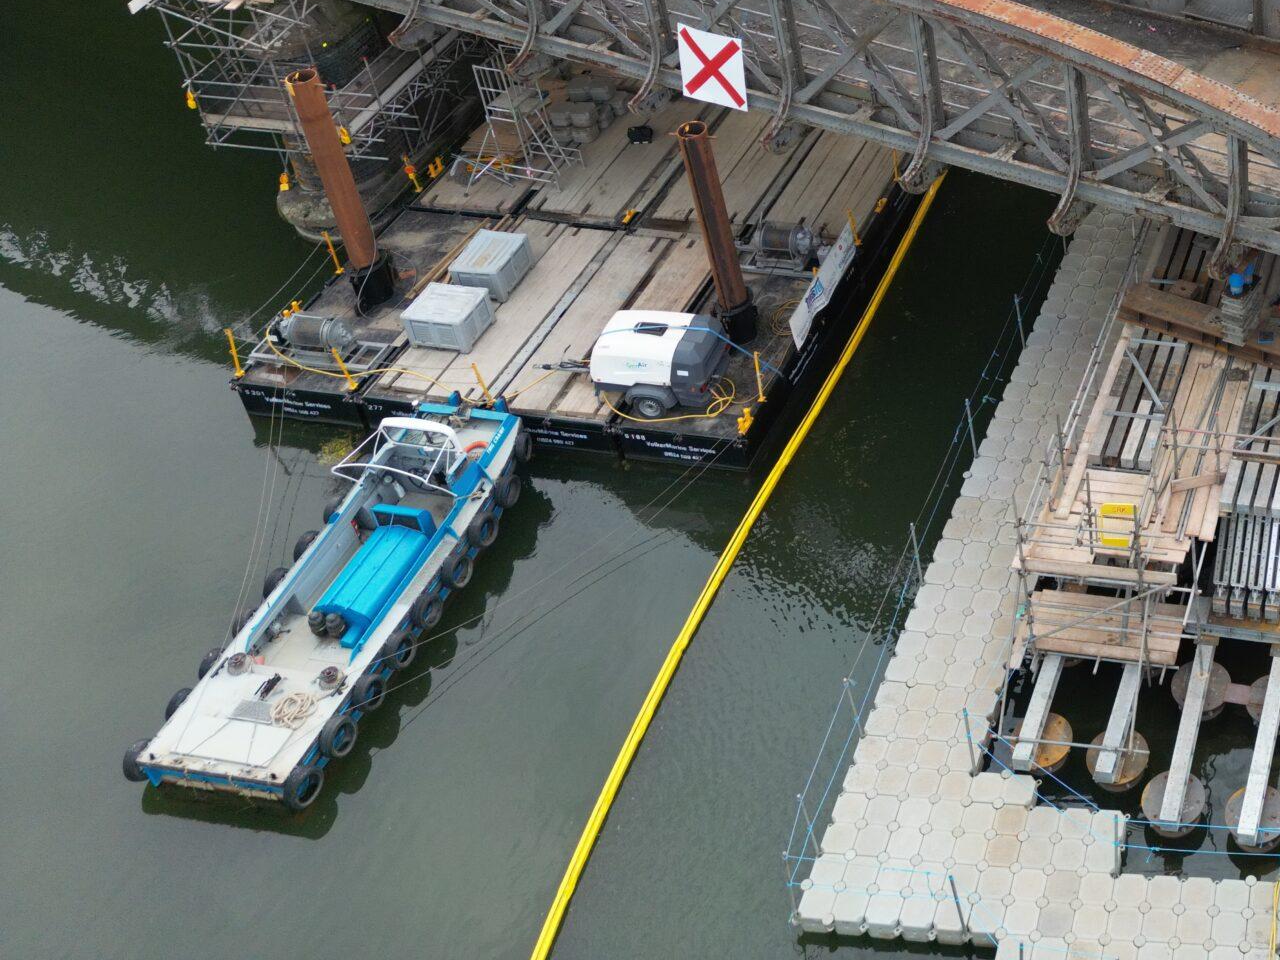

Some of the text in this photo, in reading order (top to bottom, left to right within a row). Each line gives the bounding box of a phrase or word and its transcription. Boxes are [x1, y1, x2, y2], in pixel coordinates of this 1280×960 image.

[304, 401, 332, 409] Services
[560, 431, 588, 440] Services
[688, 445, 716, 454] Services
